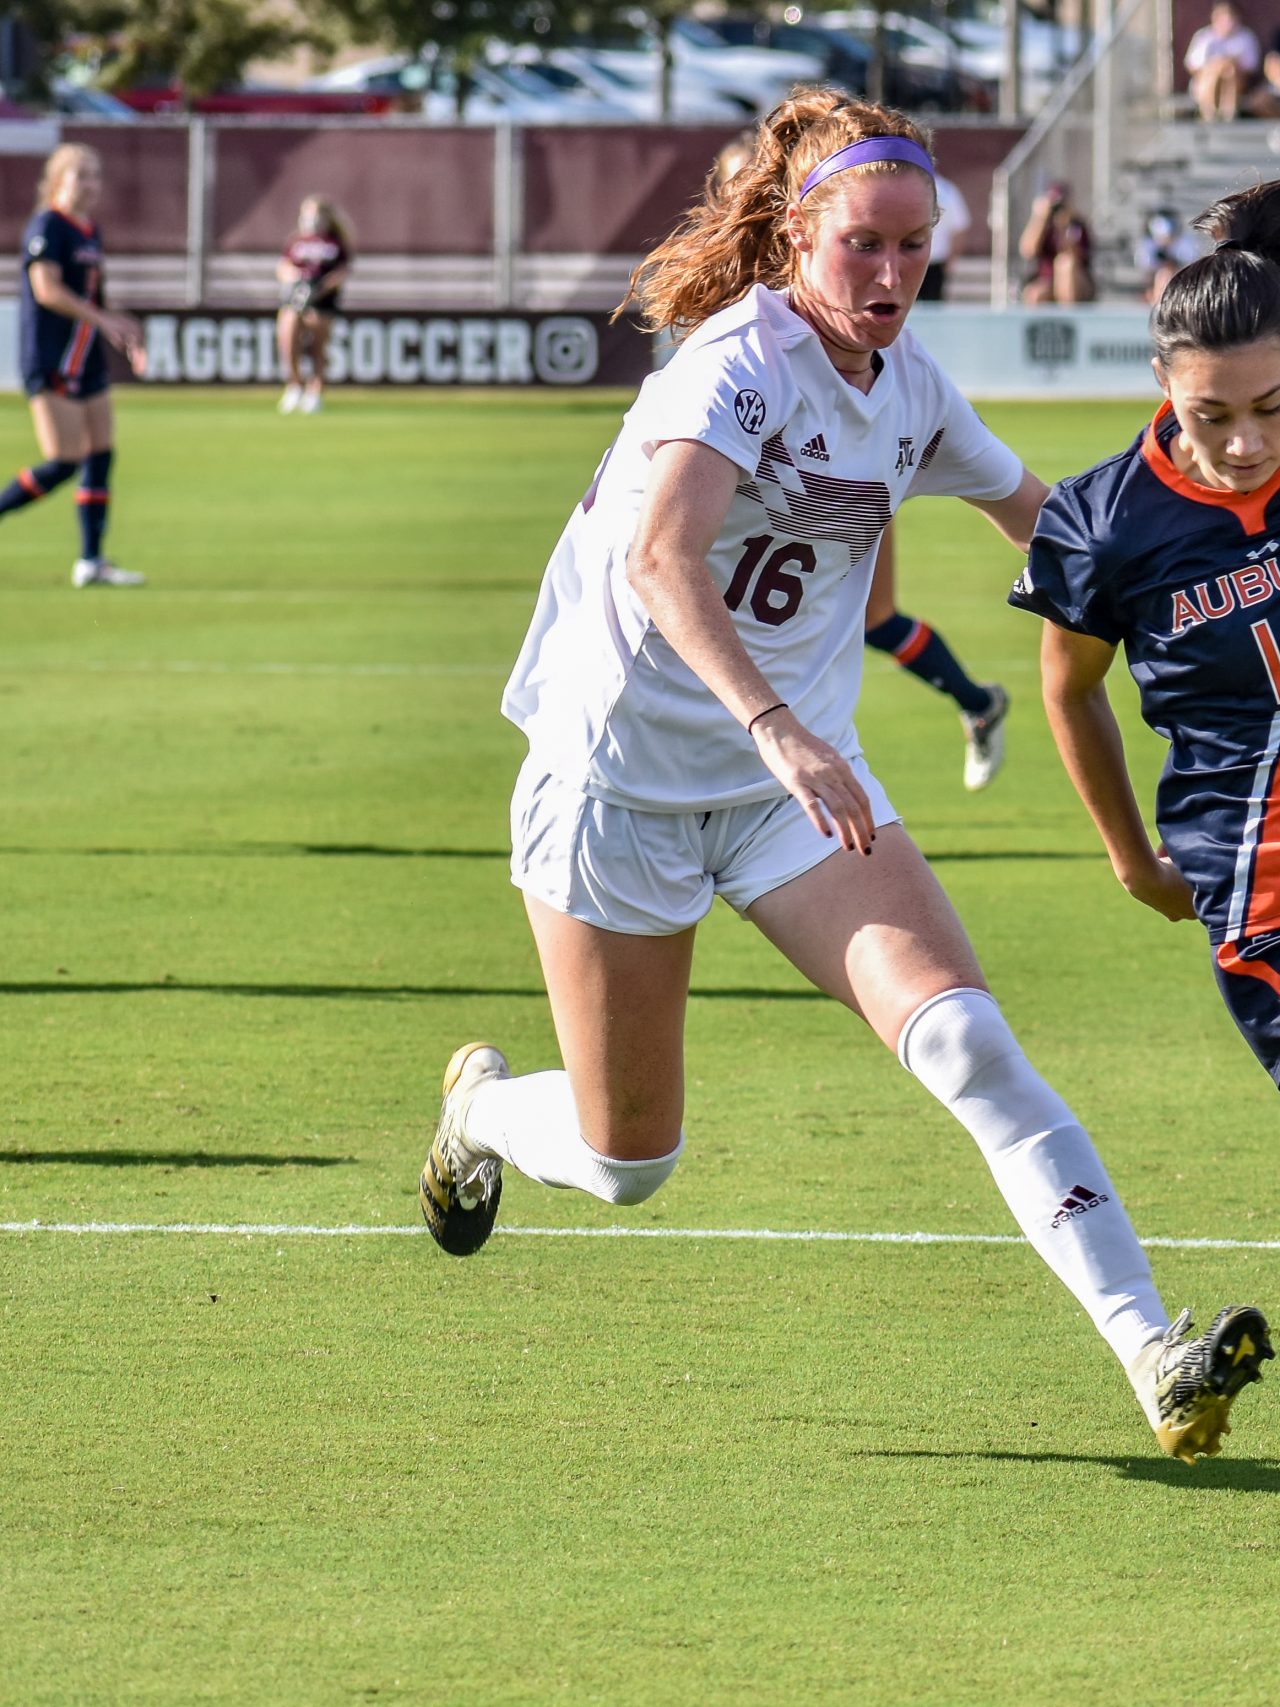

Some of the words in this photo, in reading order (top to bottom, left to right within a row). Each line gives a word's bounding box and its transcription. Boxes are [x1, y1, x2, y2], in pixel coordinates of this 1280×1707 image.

[144, 316, 313, 381] AGGI
[322, 316, 534, 382] SOCCER
[800, 447, 830, 462] adidas
[723, 534, 817, 627] 16
[1051, 1194, 1109, 1229] adidas
